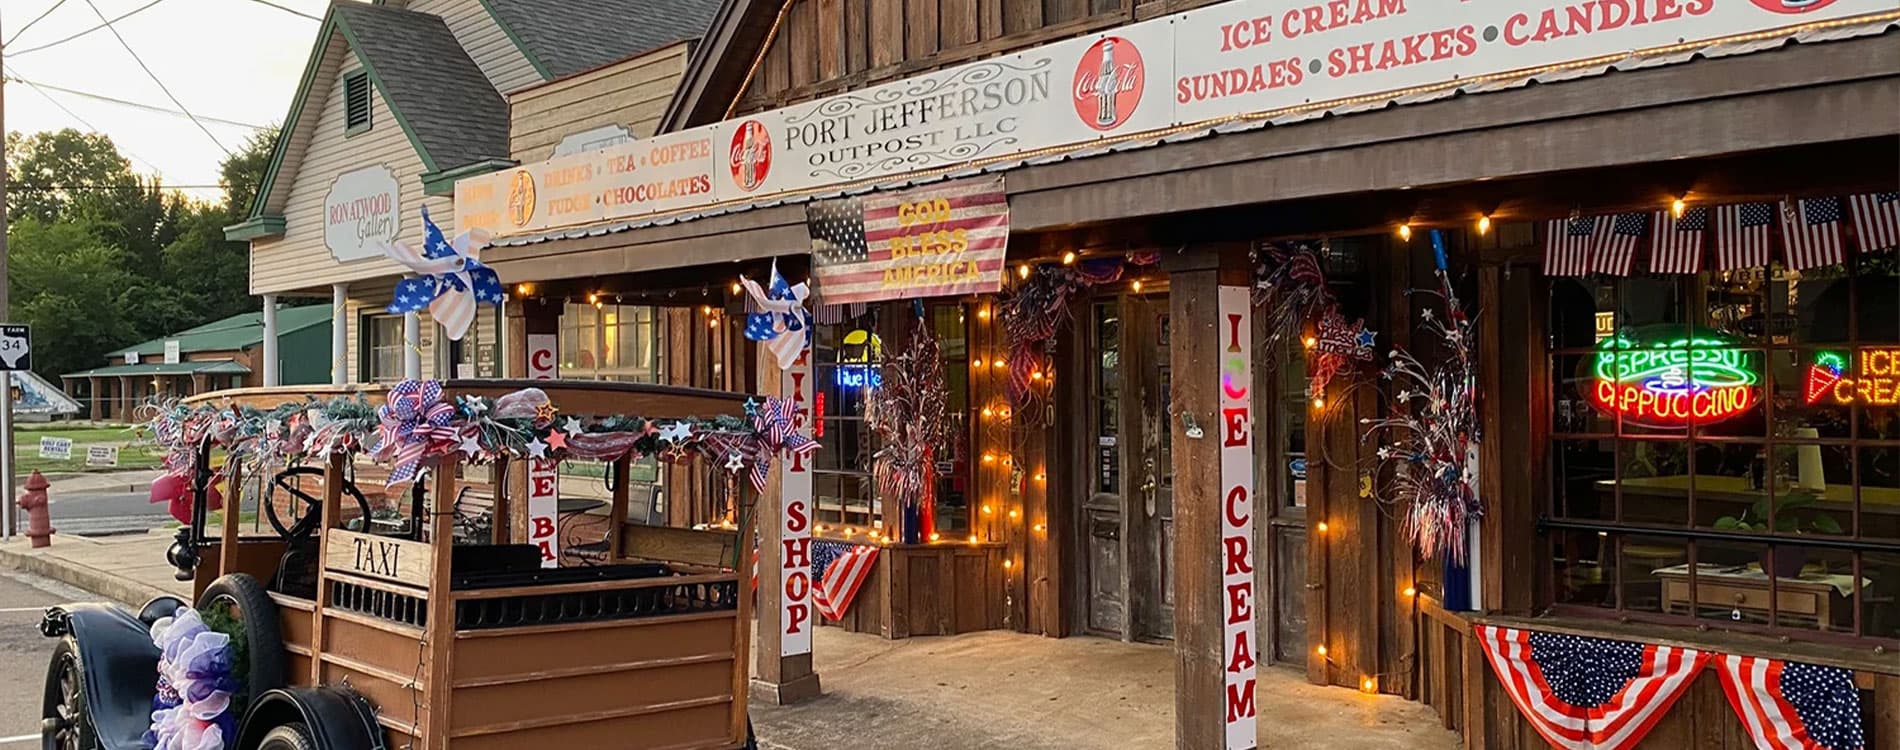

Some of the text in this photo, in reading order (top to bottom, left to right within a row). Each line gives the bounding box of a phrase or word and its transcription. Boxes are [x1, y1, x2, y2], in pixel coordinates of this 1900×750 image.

[1221, 15, 1272, 52] ICE
[1177, 57, 1303, 104] SUNDAES
[1327, 25, 1477, 78] SHAKES
[785, 71, 1052, 151] PORT JEFFERSON
[607, 153, 636, 176] TEA
[649, 138, 711, 168] COFFEE
[809, 116, 1018, 168] OUTPOST LLC
[603, 174, 711, 208] CHOCOLATES
[899, 197, 951, 226] GOD
[357, 213, 393, 249] Gallery
[890, 228, 969, 260] BLESS
[880, 259, 980, 290] AMERICA
[2, 339, 20, 351] 34
[1223, 313, 1257, 724] ICE CREAM
[353, 537, 401, 578] TAXI
[783, 501, 811, 635] SHOP
